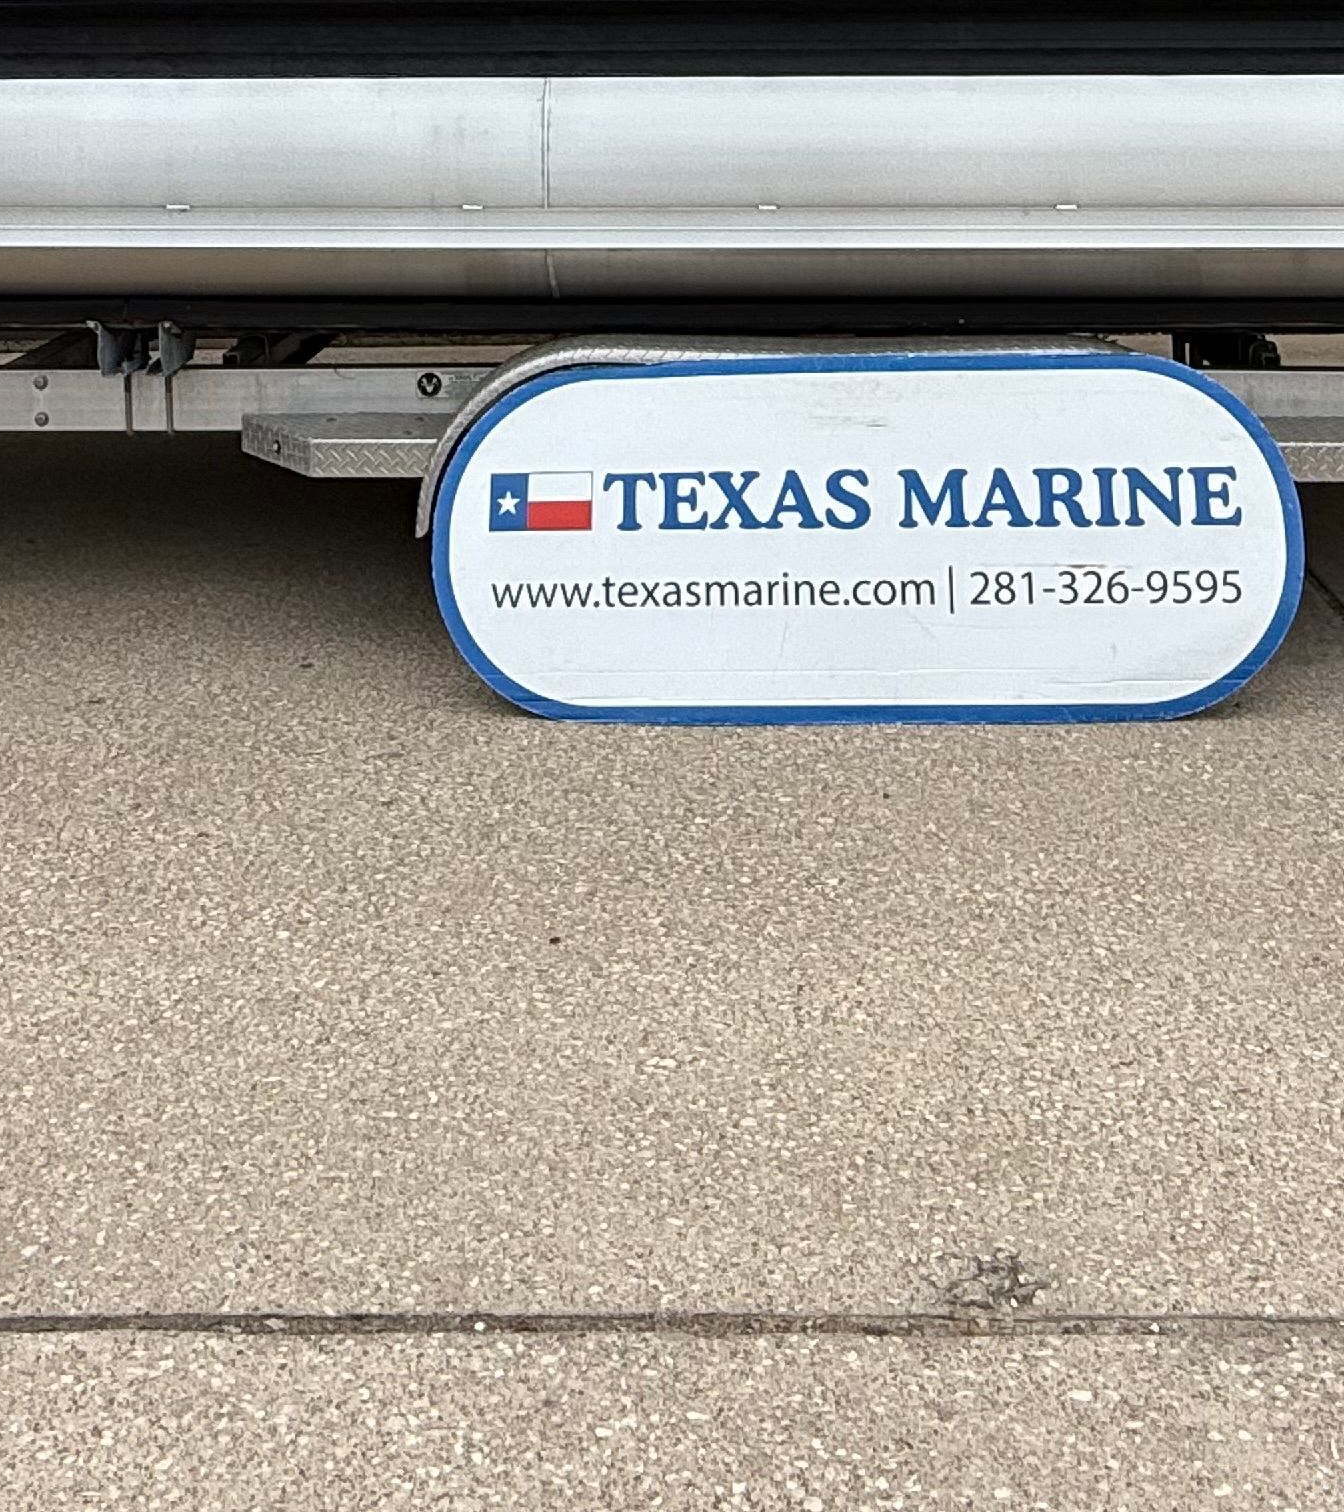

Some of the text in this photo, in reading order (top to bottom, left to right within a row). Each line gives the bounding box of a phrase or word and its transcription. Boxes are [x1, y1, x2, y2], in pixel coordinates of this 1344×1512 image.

[603, 465, 1244, 532] TEXAS MARINE
[491, 568, 1244, 612] www.texasmarine.com 281-326-9595
